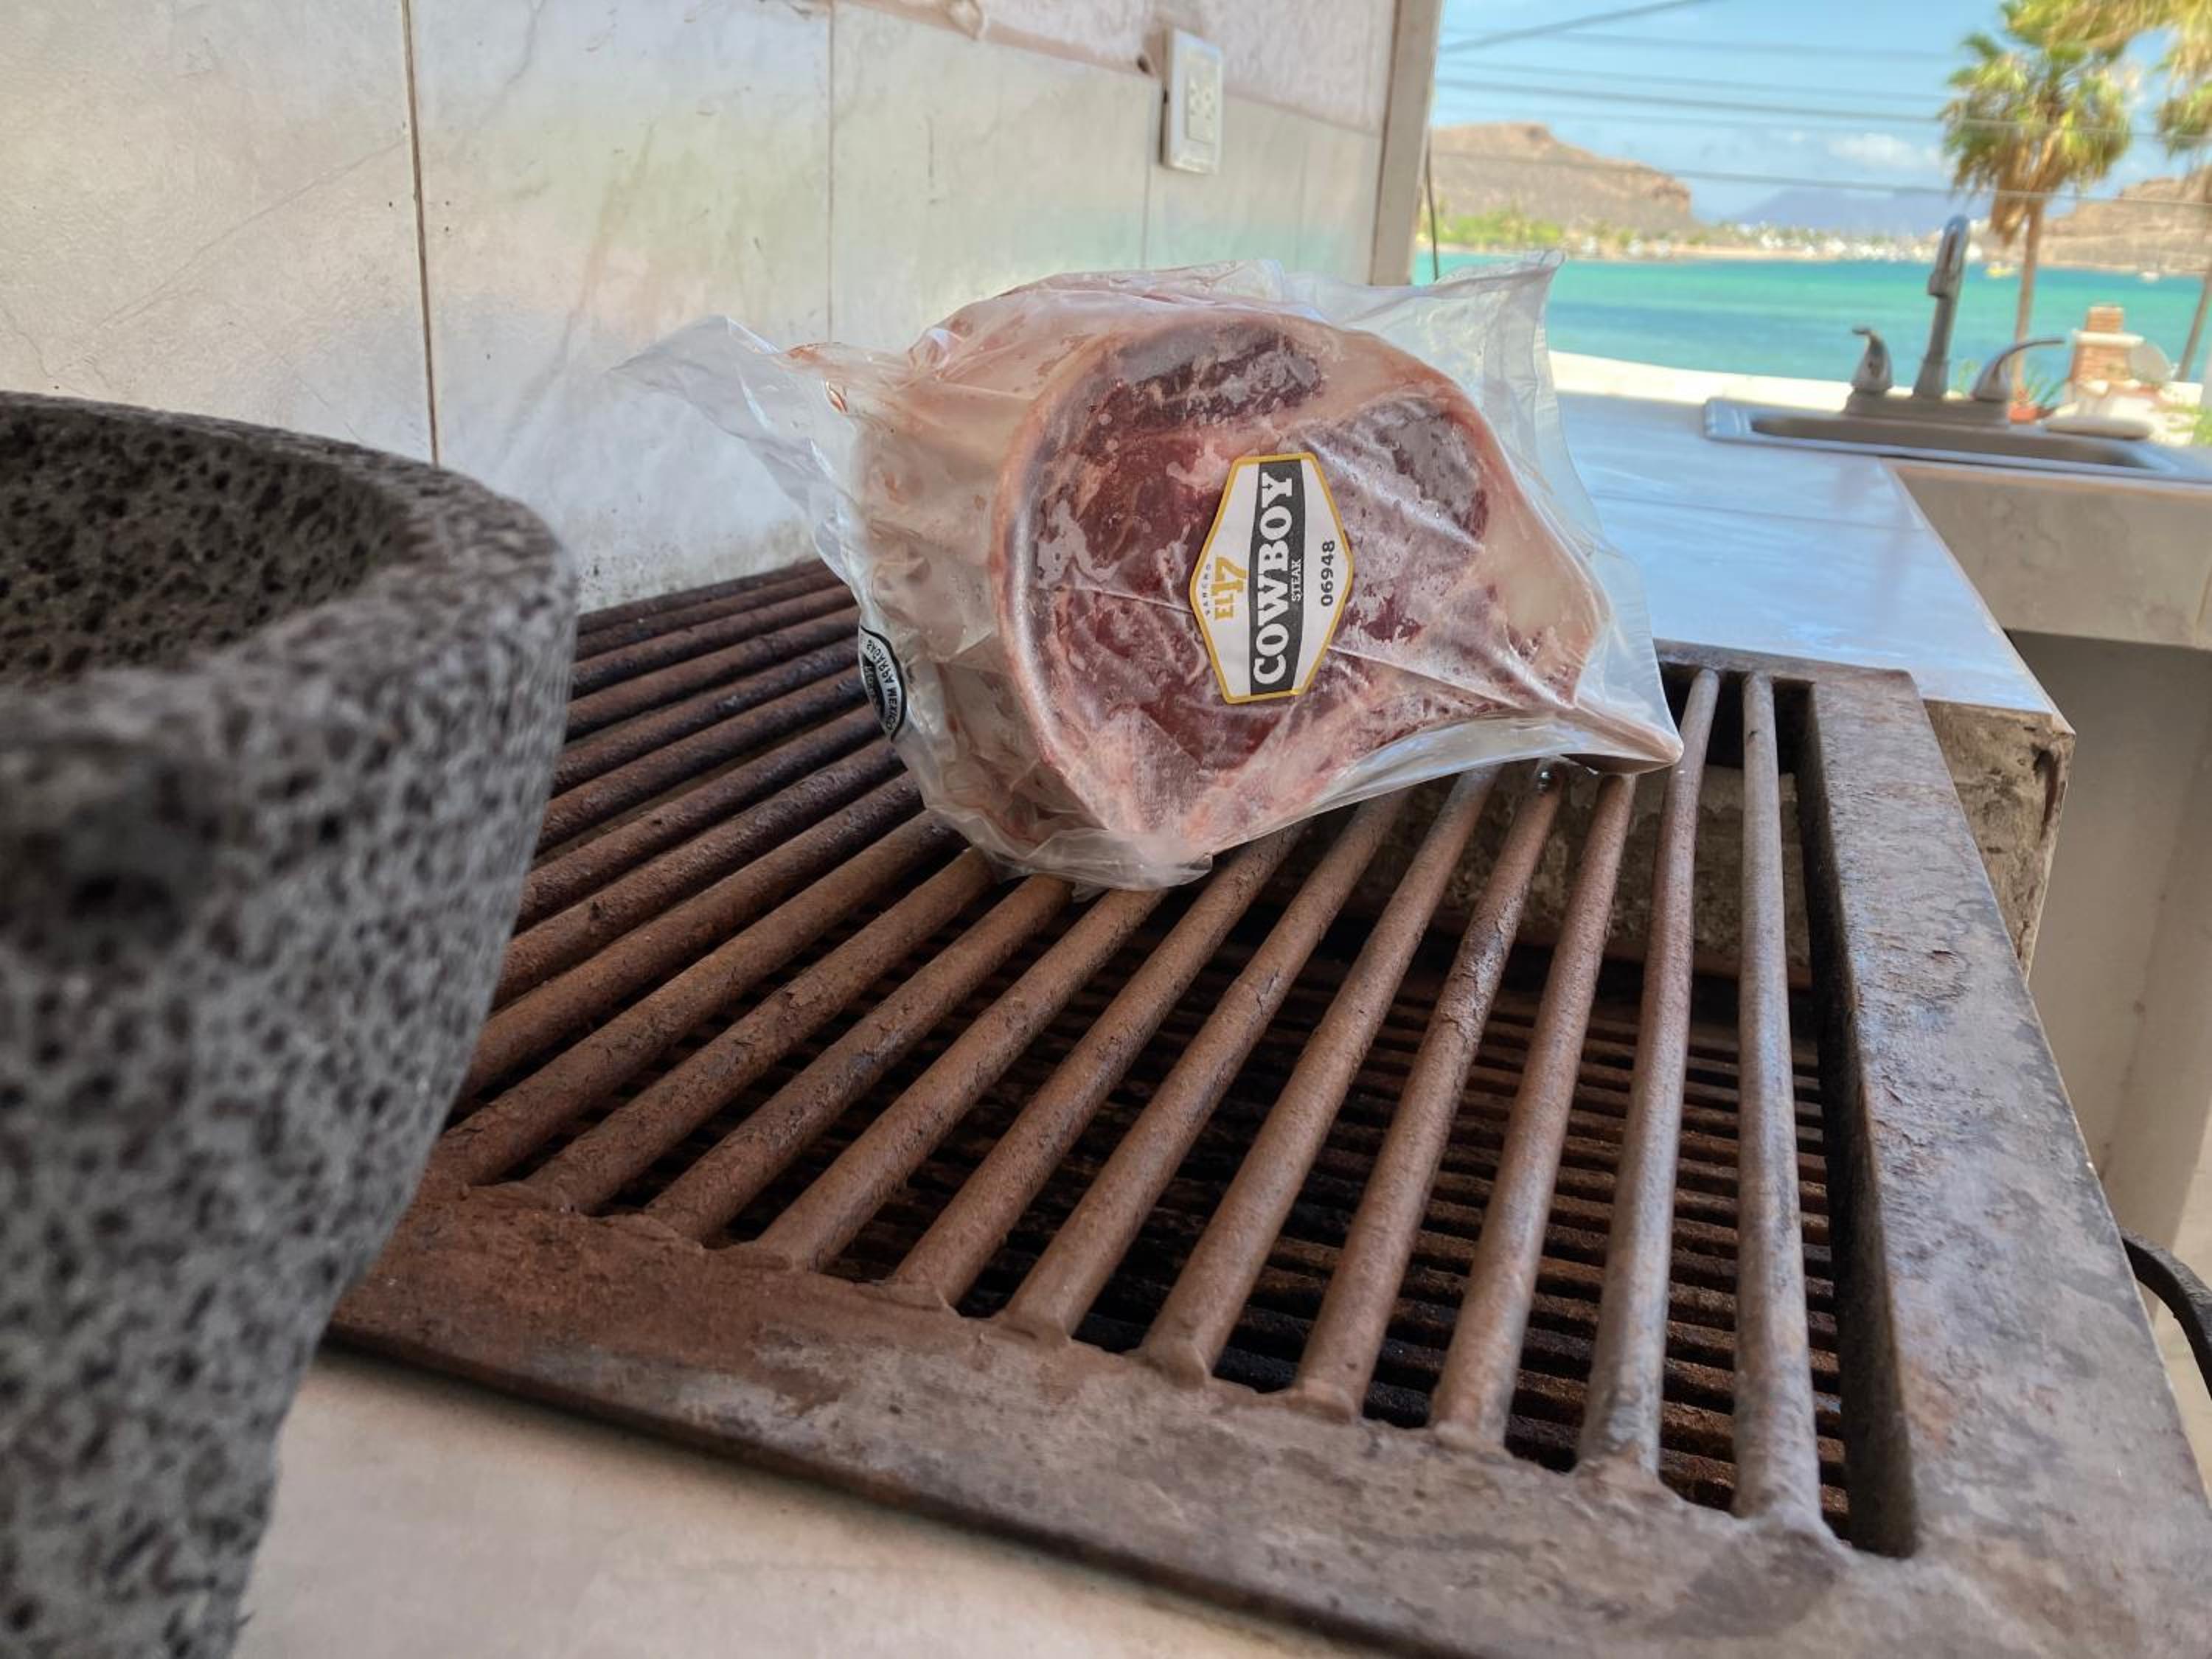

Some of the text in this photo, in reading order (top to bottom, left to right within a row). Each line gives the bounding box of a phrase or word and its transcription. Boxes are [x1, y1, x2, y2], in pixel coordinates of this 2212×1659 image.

[1253, 472, 1293, 685] COWBOY
[1292, 558, 1302, 602] STEAK
[1321, 540, 1335, 607] 06948
